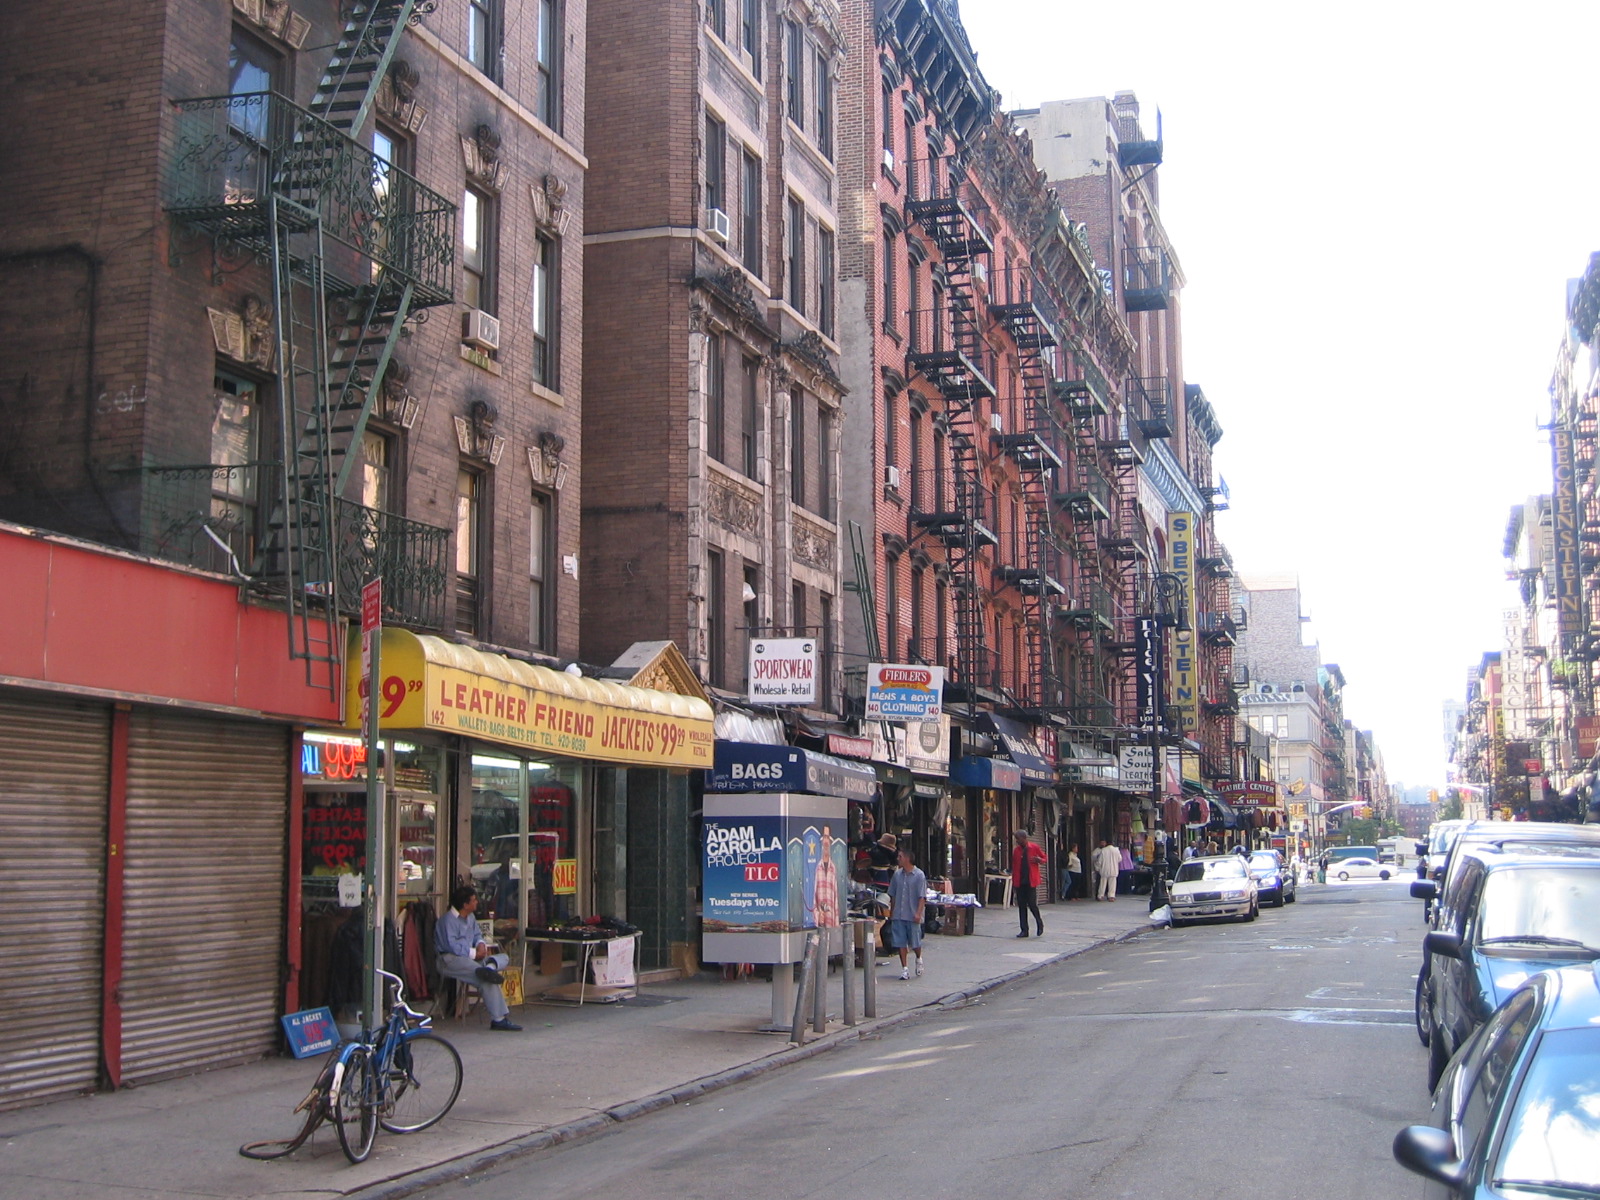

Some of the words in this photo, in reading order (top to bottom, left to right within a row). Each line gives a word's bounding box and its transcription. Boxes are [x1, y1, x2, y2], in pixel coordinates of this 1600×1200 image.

[1554, 432, 1579, 612] BECKENSTEIN
[1173, 541, 1192, 700] BECTEIN
[1503, 611, 1519, 619] 125
[753, 658, 813, 680] SPORTSWEAR
[885, 670, 927, 682] FIEDLER'S
[753, 683, 787, 695] Wholesale
[792, 683, 811, 695] Retail
[871, 692, 897, 700] MENS
[900, 693, 907, 701] &
[911, 694, 936, 702] BOYS
[867, 704, 879, 712] 140
[927, 706, 940, 715] 140
[882, 702, 924, 713] CLOTHING
[431, 710, 445, 725] 142
[441, 680, 527, 725] LEATHER
[535, 703, 594, 738] FRIEND
[601, 715, 654, 752] JACKETS
[732, 762, 783, 779] BAGS
[1125, 771, 1153, 779] LEATHE
[1126, 780, 1153, 789] CENTE
[1249, 783, 1275, 793] CENTER
[707, 826, 755, 844] ADAM
[706, 836, 783, 856] CAROLLA
[707, 850, 764, 868] PROJECT
[555, 865, 576, 888] SALE
[745, 866, 779, 880] TLC
[709, 898, 752, 907] Tuesdays
[754, 898, 779, 907] 10/9c
